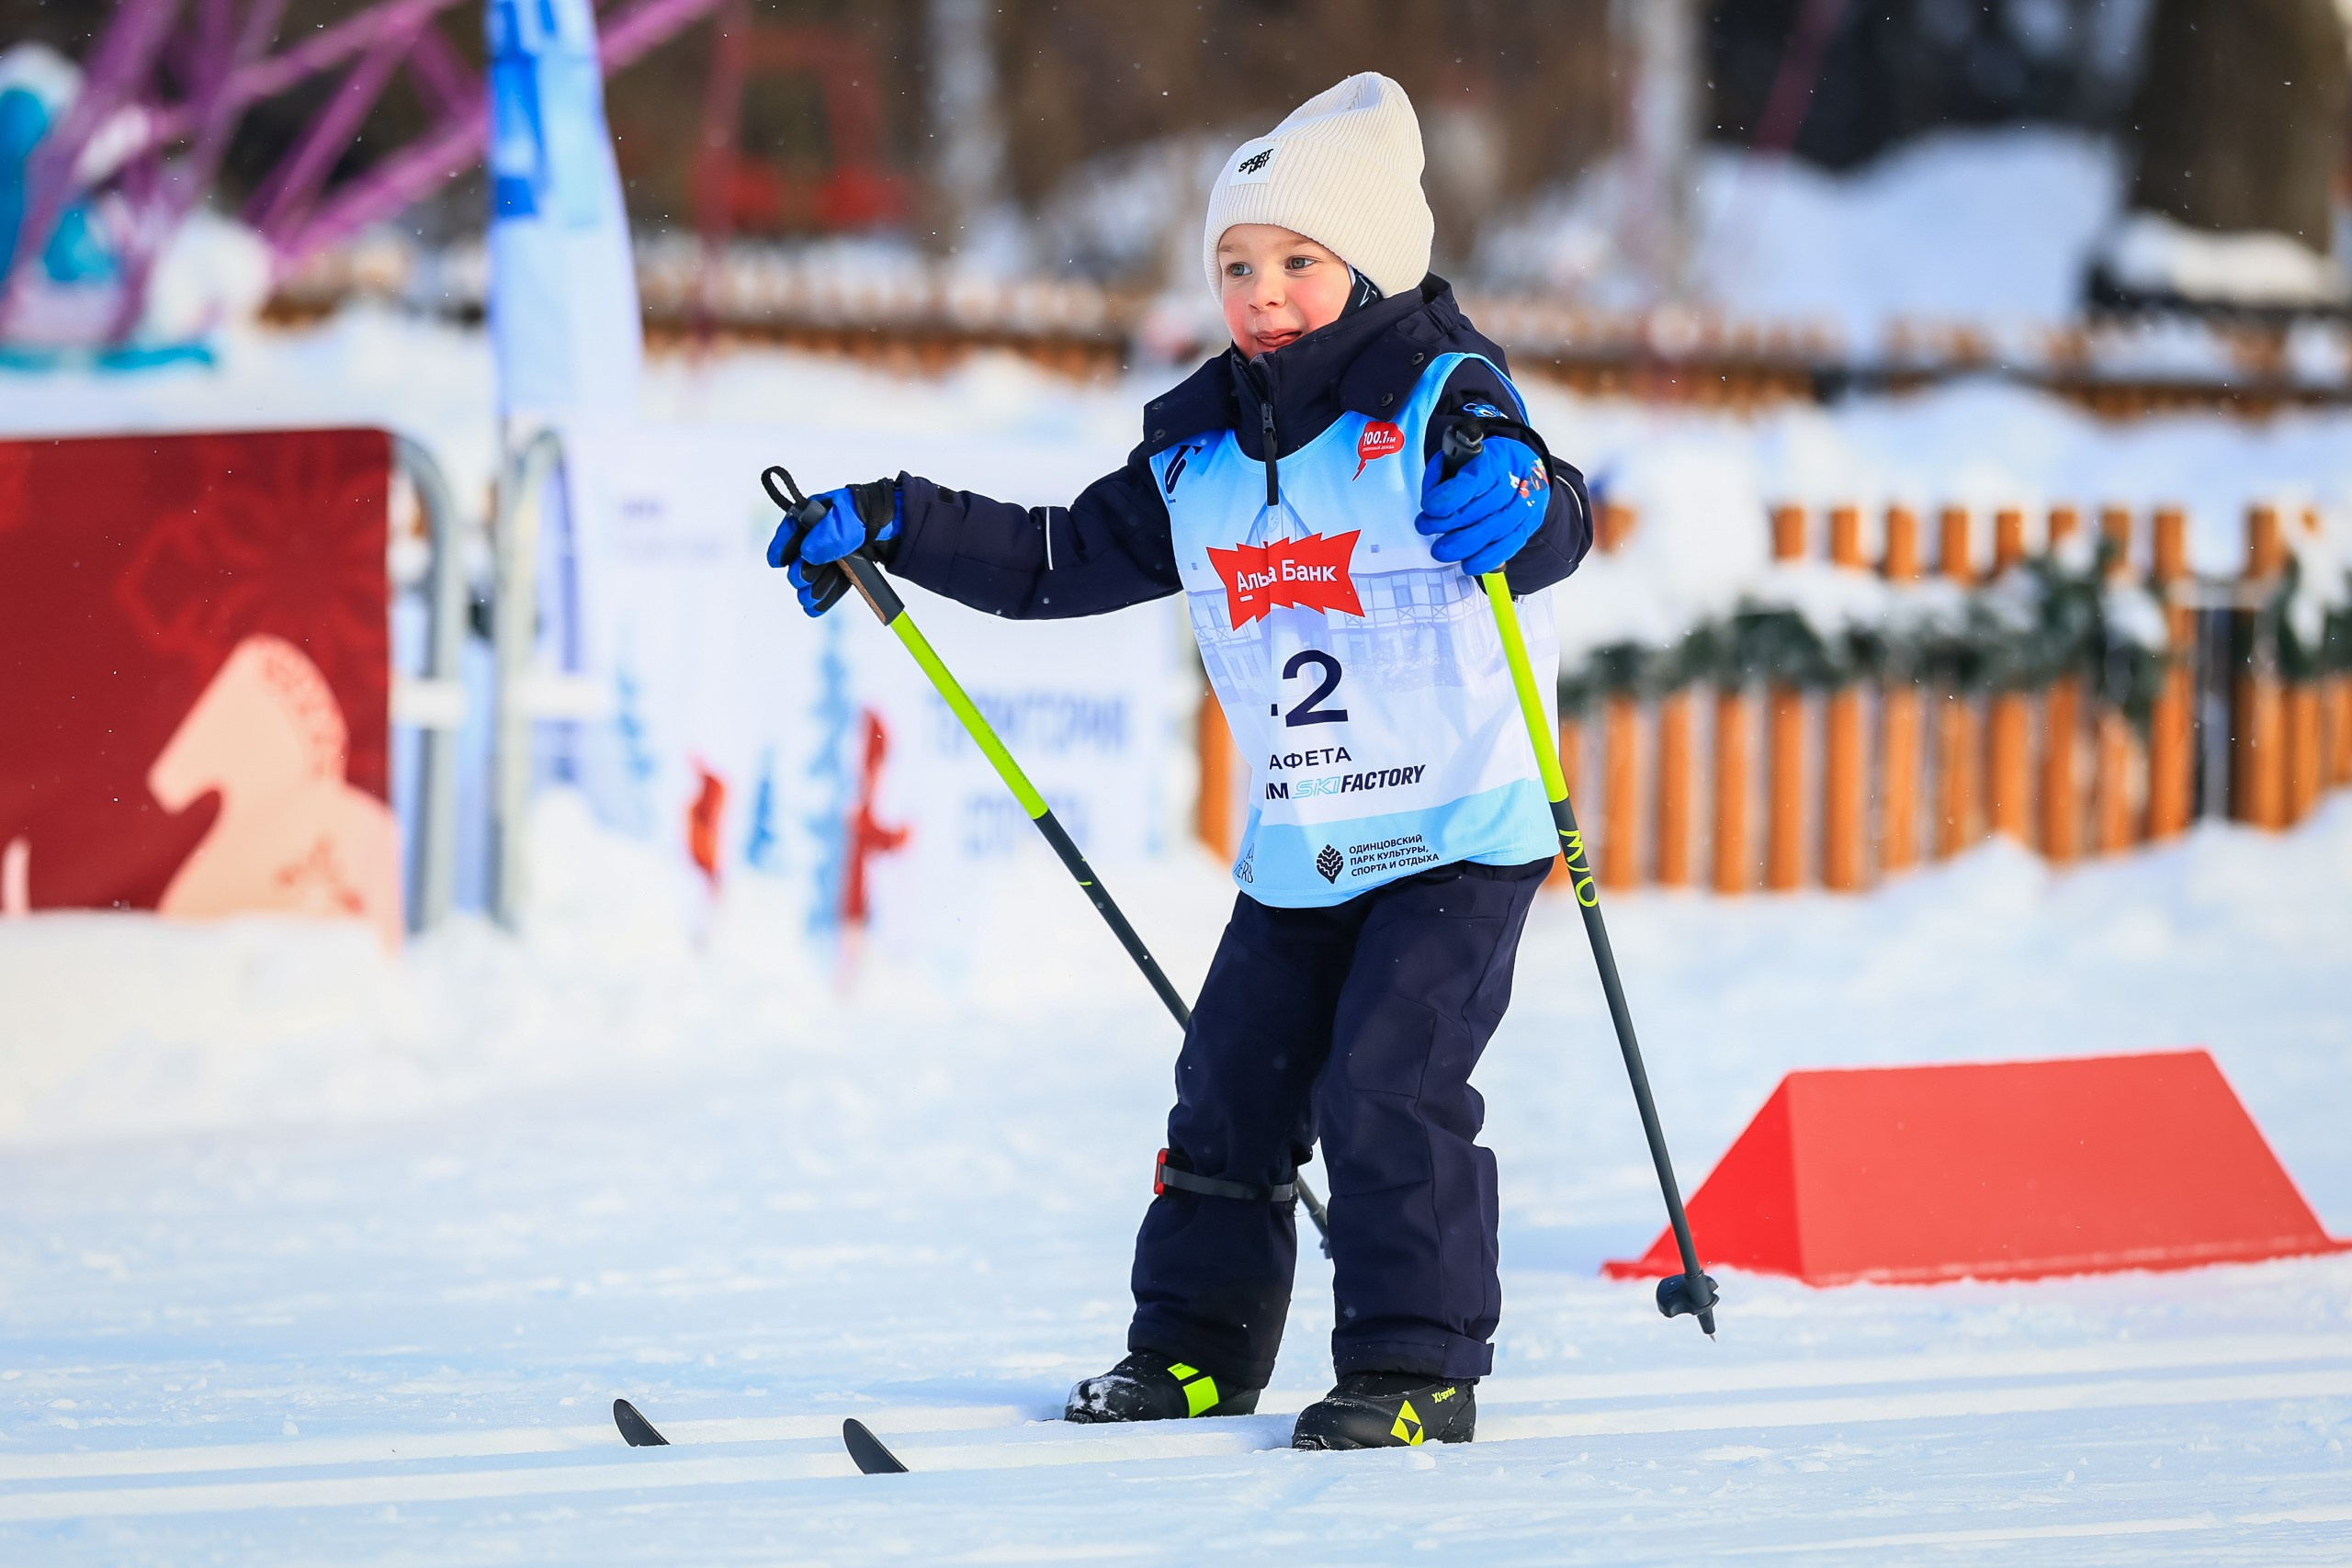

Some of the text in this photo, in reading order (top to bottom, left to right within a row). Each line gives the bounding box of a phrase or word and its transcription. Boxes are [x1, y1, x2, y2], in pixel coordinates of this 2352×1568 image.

[1238, 148, 1274, 173] SPORT
[1281, 558, 1338, 581] Банк
[1349, 834, 1423, 854] ОДИНЦОВСКИЙ
[1350, 845, 1430, 866] ПАРК КУЛЬТУРЫ,
[1351, 853, 1440, 877] СПОРТА И ОТДЫХА
